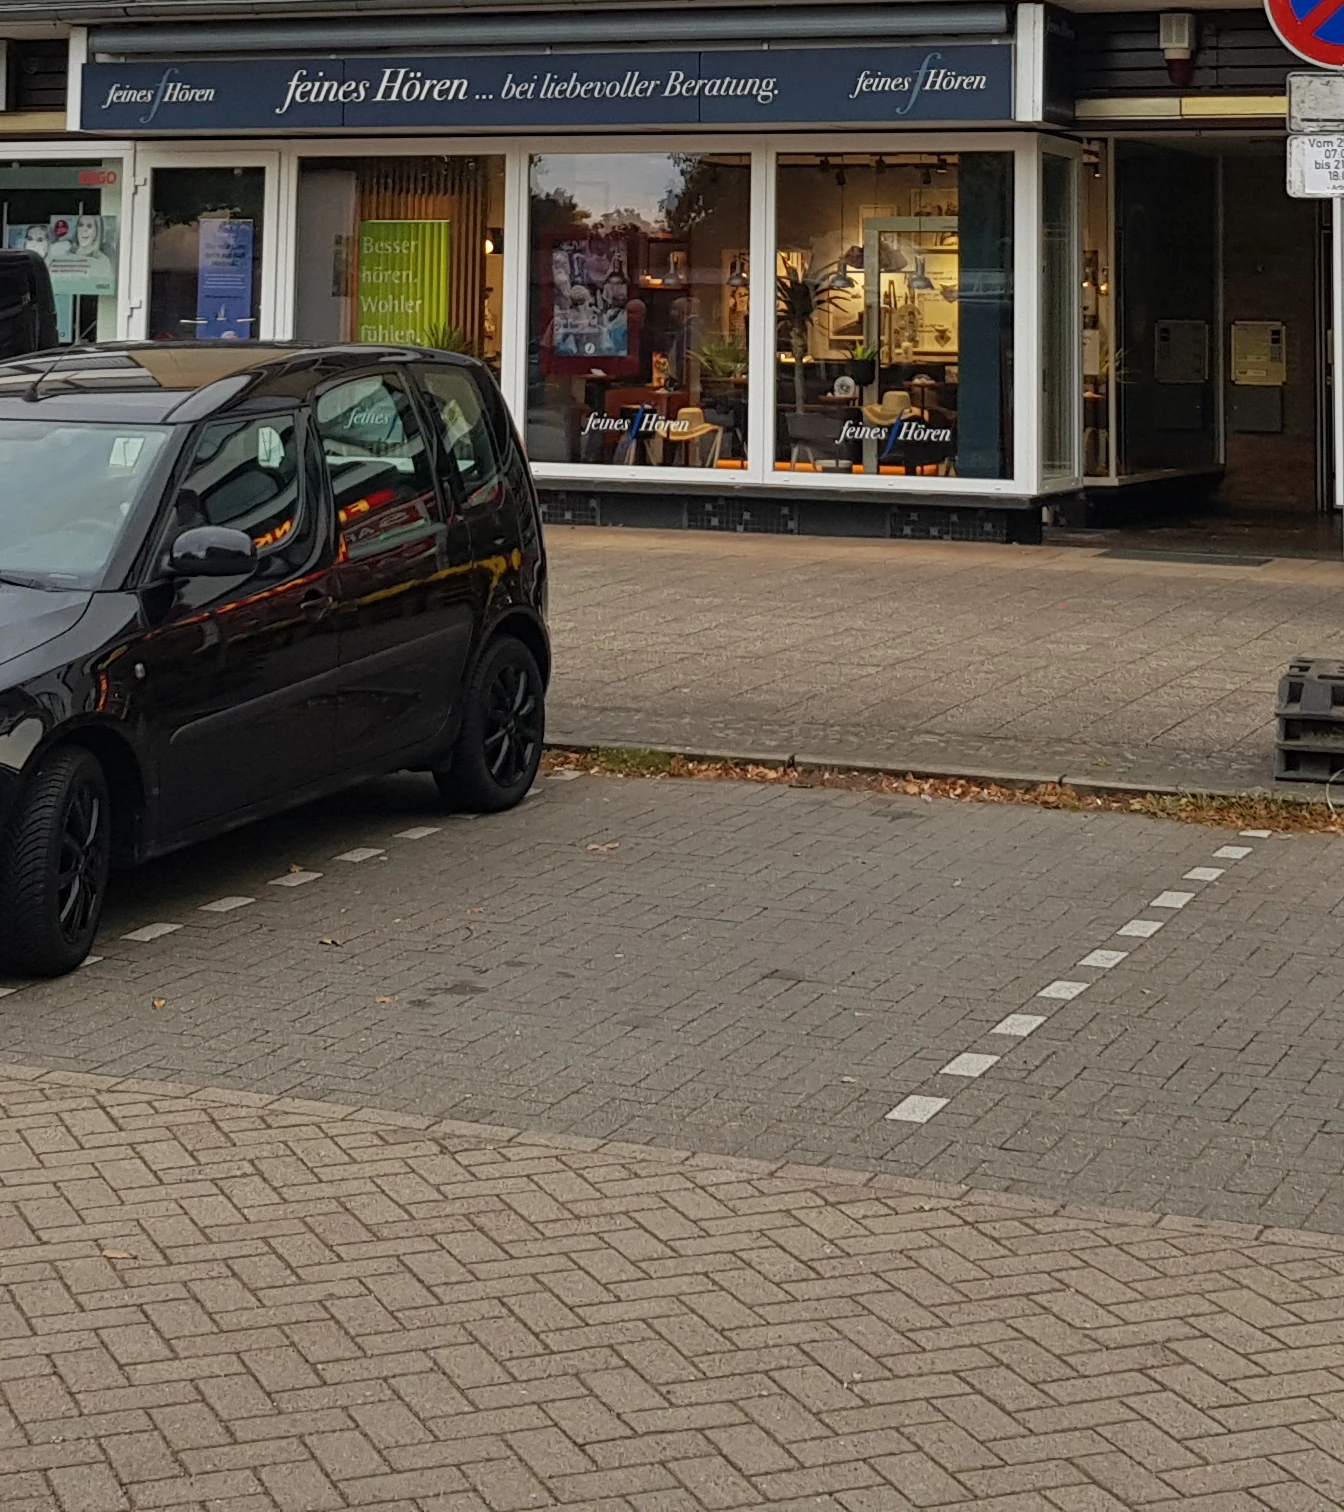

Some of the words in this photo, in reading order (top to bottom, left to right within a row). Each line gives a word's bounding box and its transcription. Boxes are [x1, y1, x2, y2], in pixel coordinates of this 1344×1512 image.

[275, 69, 366, 114] feines
[372, 68, 468, 102] Hören
[501, 73, 537, 100] bei
[539, 71, 661, 99] liebevoller
[661, 70, 780, 104] Beratung.
[849, 70, 912, 99] feines
[922, 68, 987, 91] Hören
[102, 83, 154, 109] feines
[162, 82, 216, 102] Hören
[1308, 138, 1334, 148] Vom
[1314, 159, 1331, 170] bis
[362, 236, 418, 254] Besser
[361, 266, 418, 284] hören.
[360, 295, 423, 313] Wohler
[360, 324, 421, 344] fühlen.
[343, 406, 390, 429] feines
[581, 411, 631, 436] feines
[639, 413, 690, 432] Hören
[835, 419, 888, 444] feines
[897, 421, 952, 442] Hören
